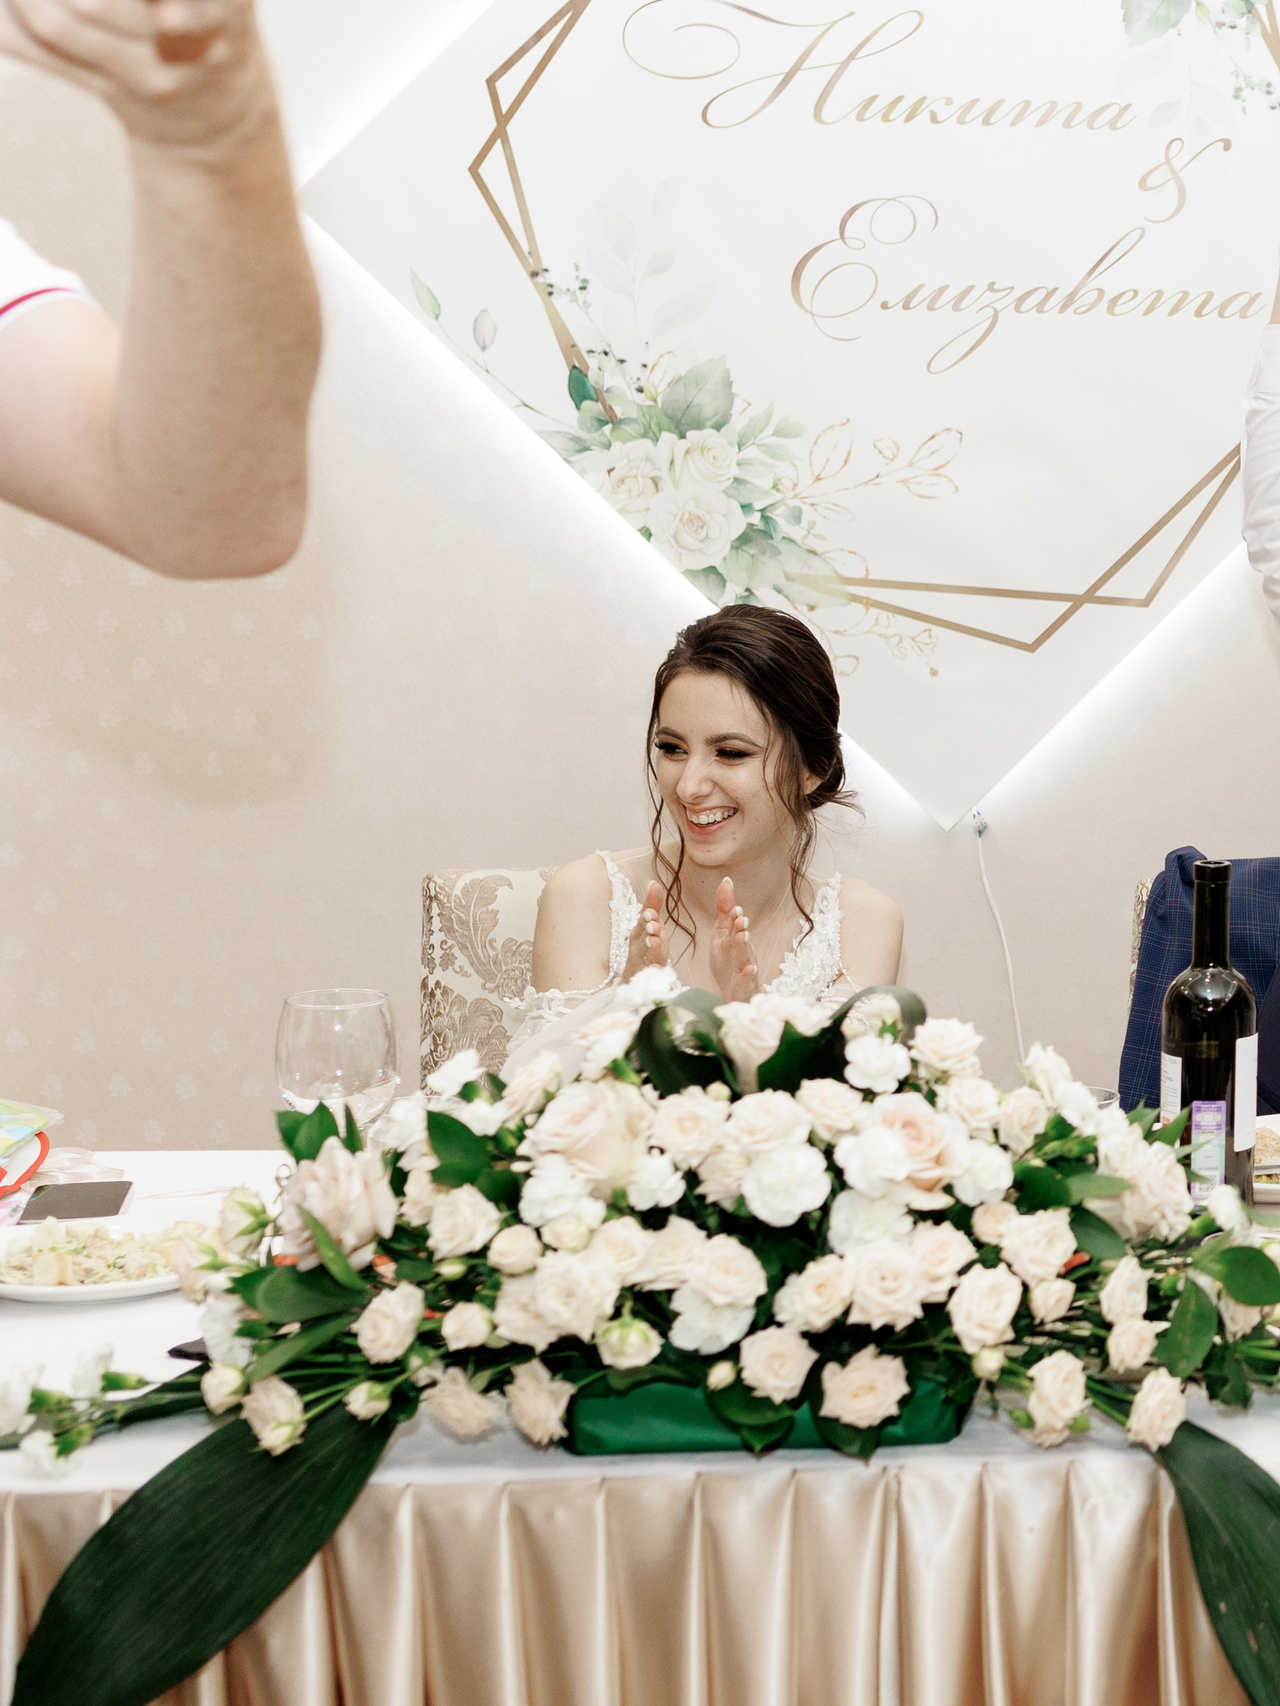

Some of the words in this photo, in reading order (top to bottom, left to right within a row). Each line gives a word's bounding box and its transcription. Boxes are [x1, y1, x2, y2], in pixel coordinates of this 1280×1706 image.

[622, 0, 1137, 131] Никита
[1137, 137, 1233, 224] &
[790, 195, 1267, 375] Елизавета
